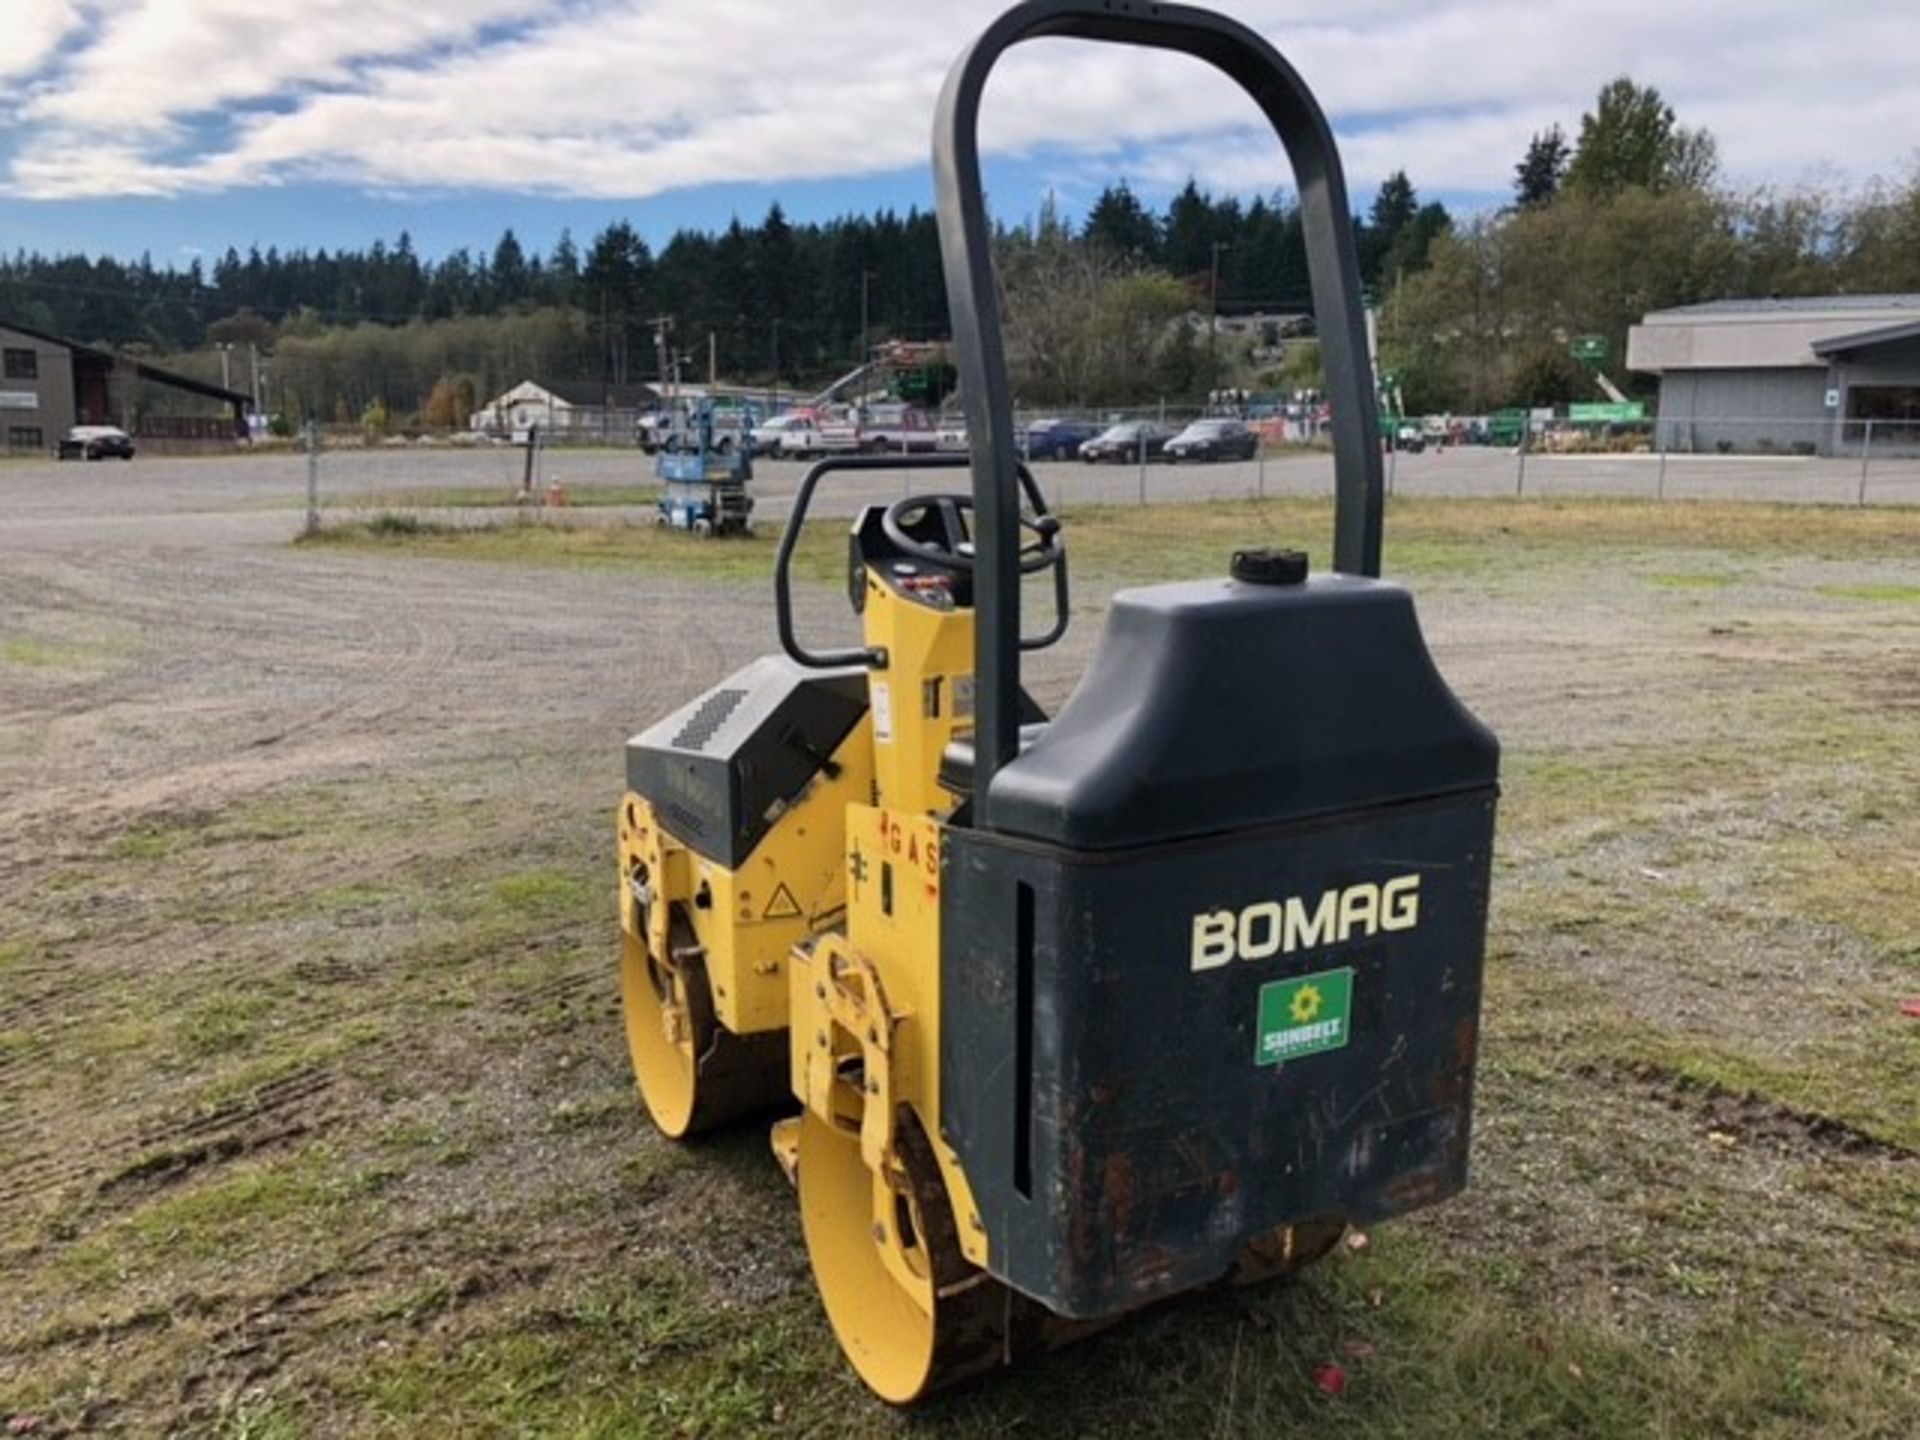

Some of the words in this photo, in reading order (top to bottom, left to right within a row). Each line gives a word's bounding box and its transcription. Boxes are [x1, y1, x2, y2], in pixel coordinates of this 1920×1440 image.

[889, 823, 938, 876] GAS
[1191, 873, 1421, 973] BOMAG
[1262, 1017, 1342, 1051] SUNBELT
